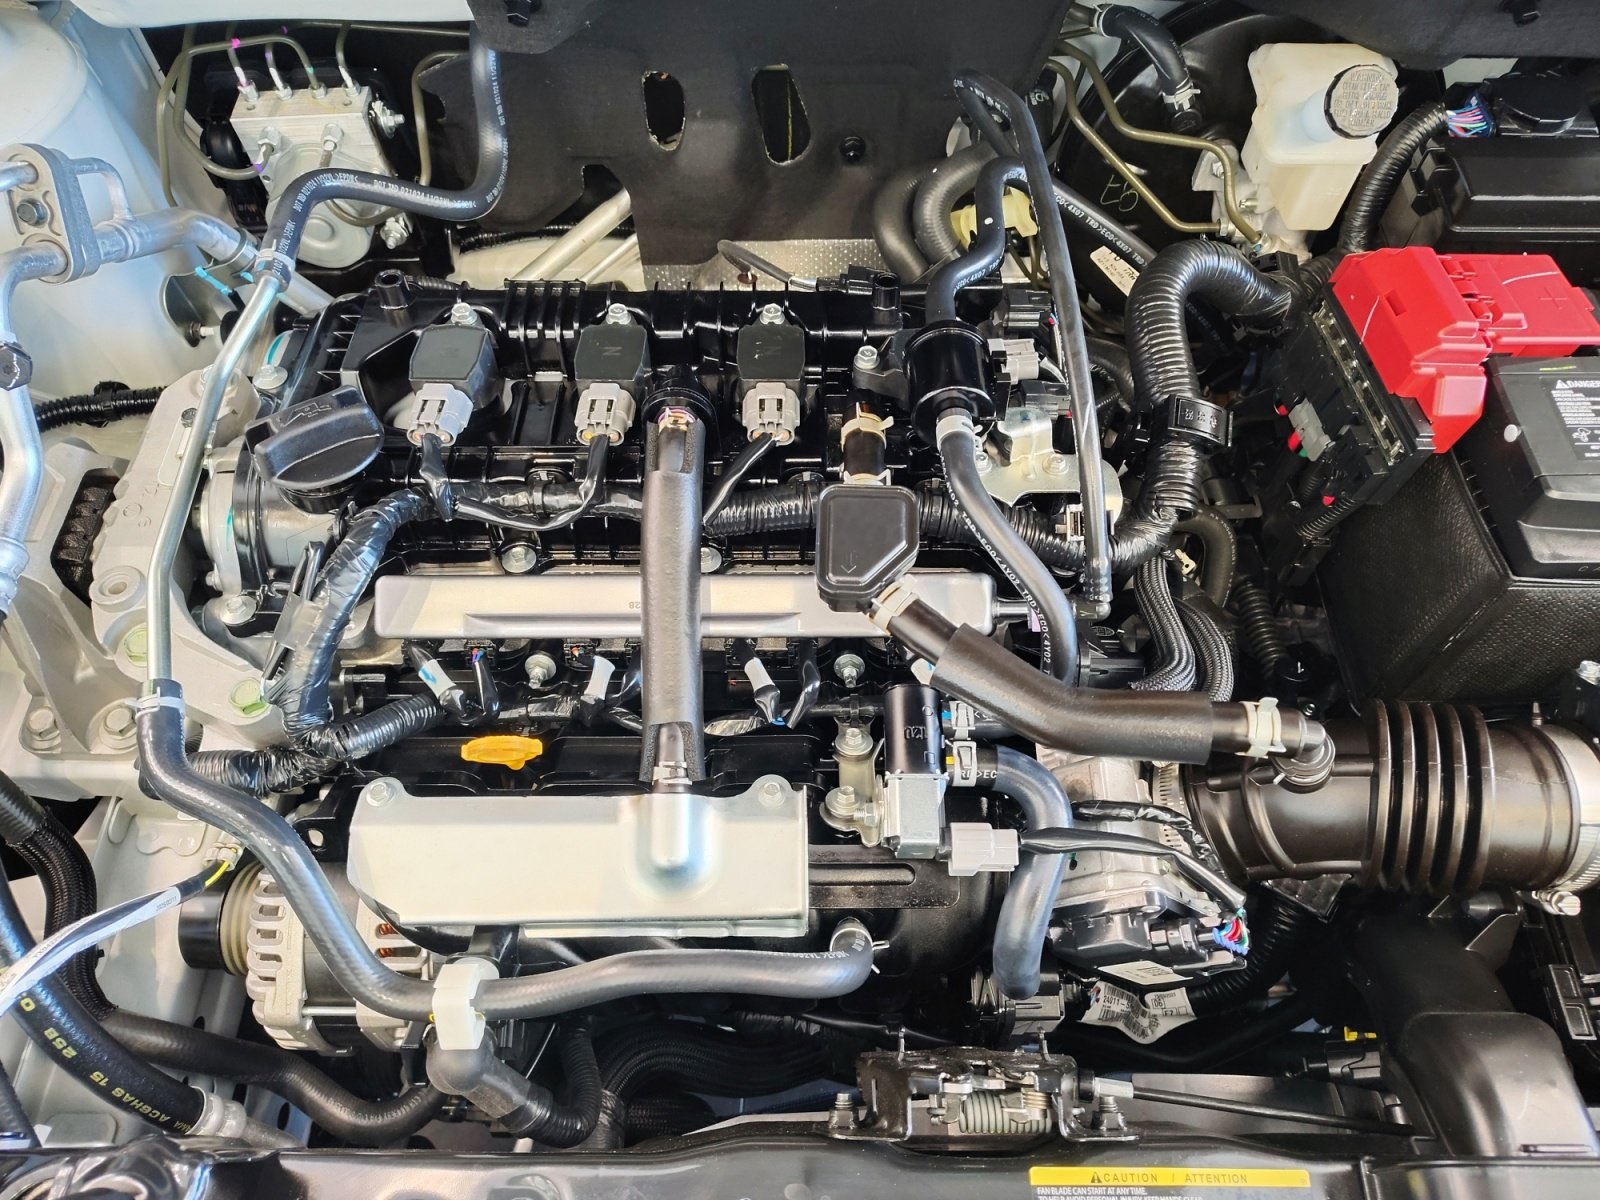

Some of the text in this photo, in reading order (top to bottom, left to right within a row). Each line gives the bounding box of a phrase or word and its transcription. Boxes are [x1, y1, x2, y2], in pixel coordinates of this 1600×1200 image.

[1104, 1173, 1158, 1183] CAUTION
[1185, 1174, 1248, 1183] ATTENTION
[1051, 1187, 1072, 1195] BLADE
[1072, 1187, 1087, 1195] CAN
[1087, 1187, 1107, 1195] START
[1107, 1187, 1115, 1195] AT
